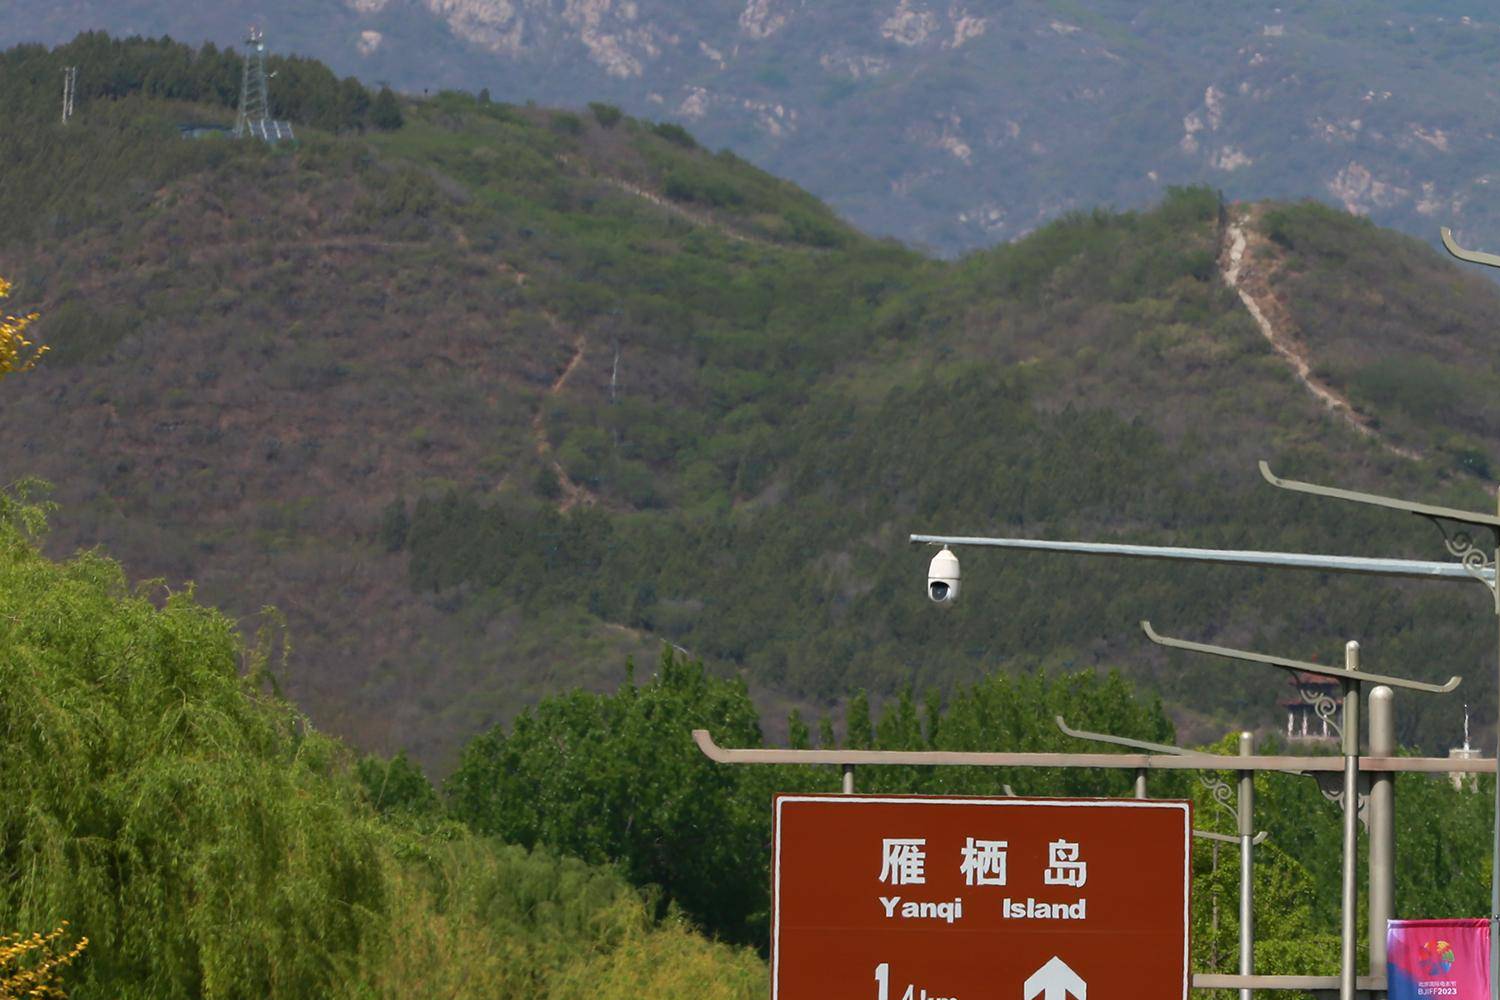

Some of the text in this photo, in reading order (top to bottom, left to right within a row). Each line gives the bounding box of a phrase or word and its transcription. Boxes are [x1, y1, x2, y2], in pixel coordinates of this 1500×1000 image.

[878, 837, 1087, 888] 雁栖岛
[879, 897, 1086, 923] Yanqi Island
[1418, 987, 1457, 995] BJIFF2023
